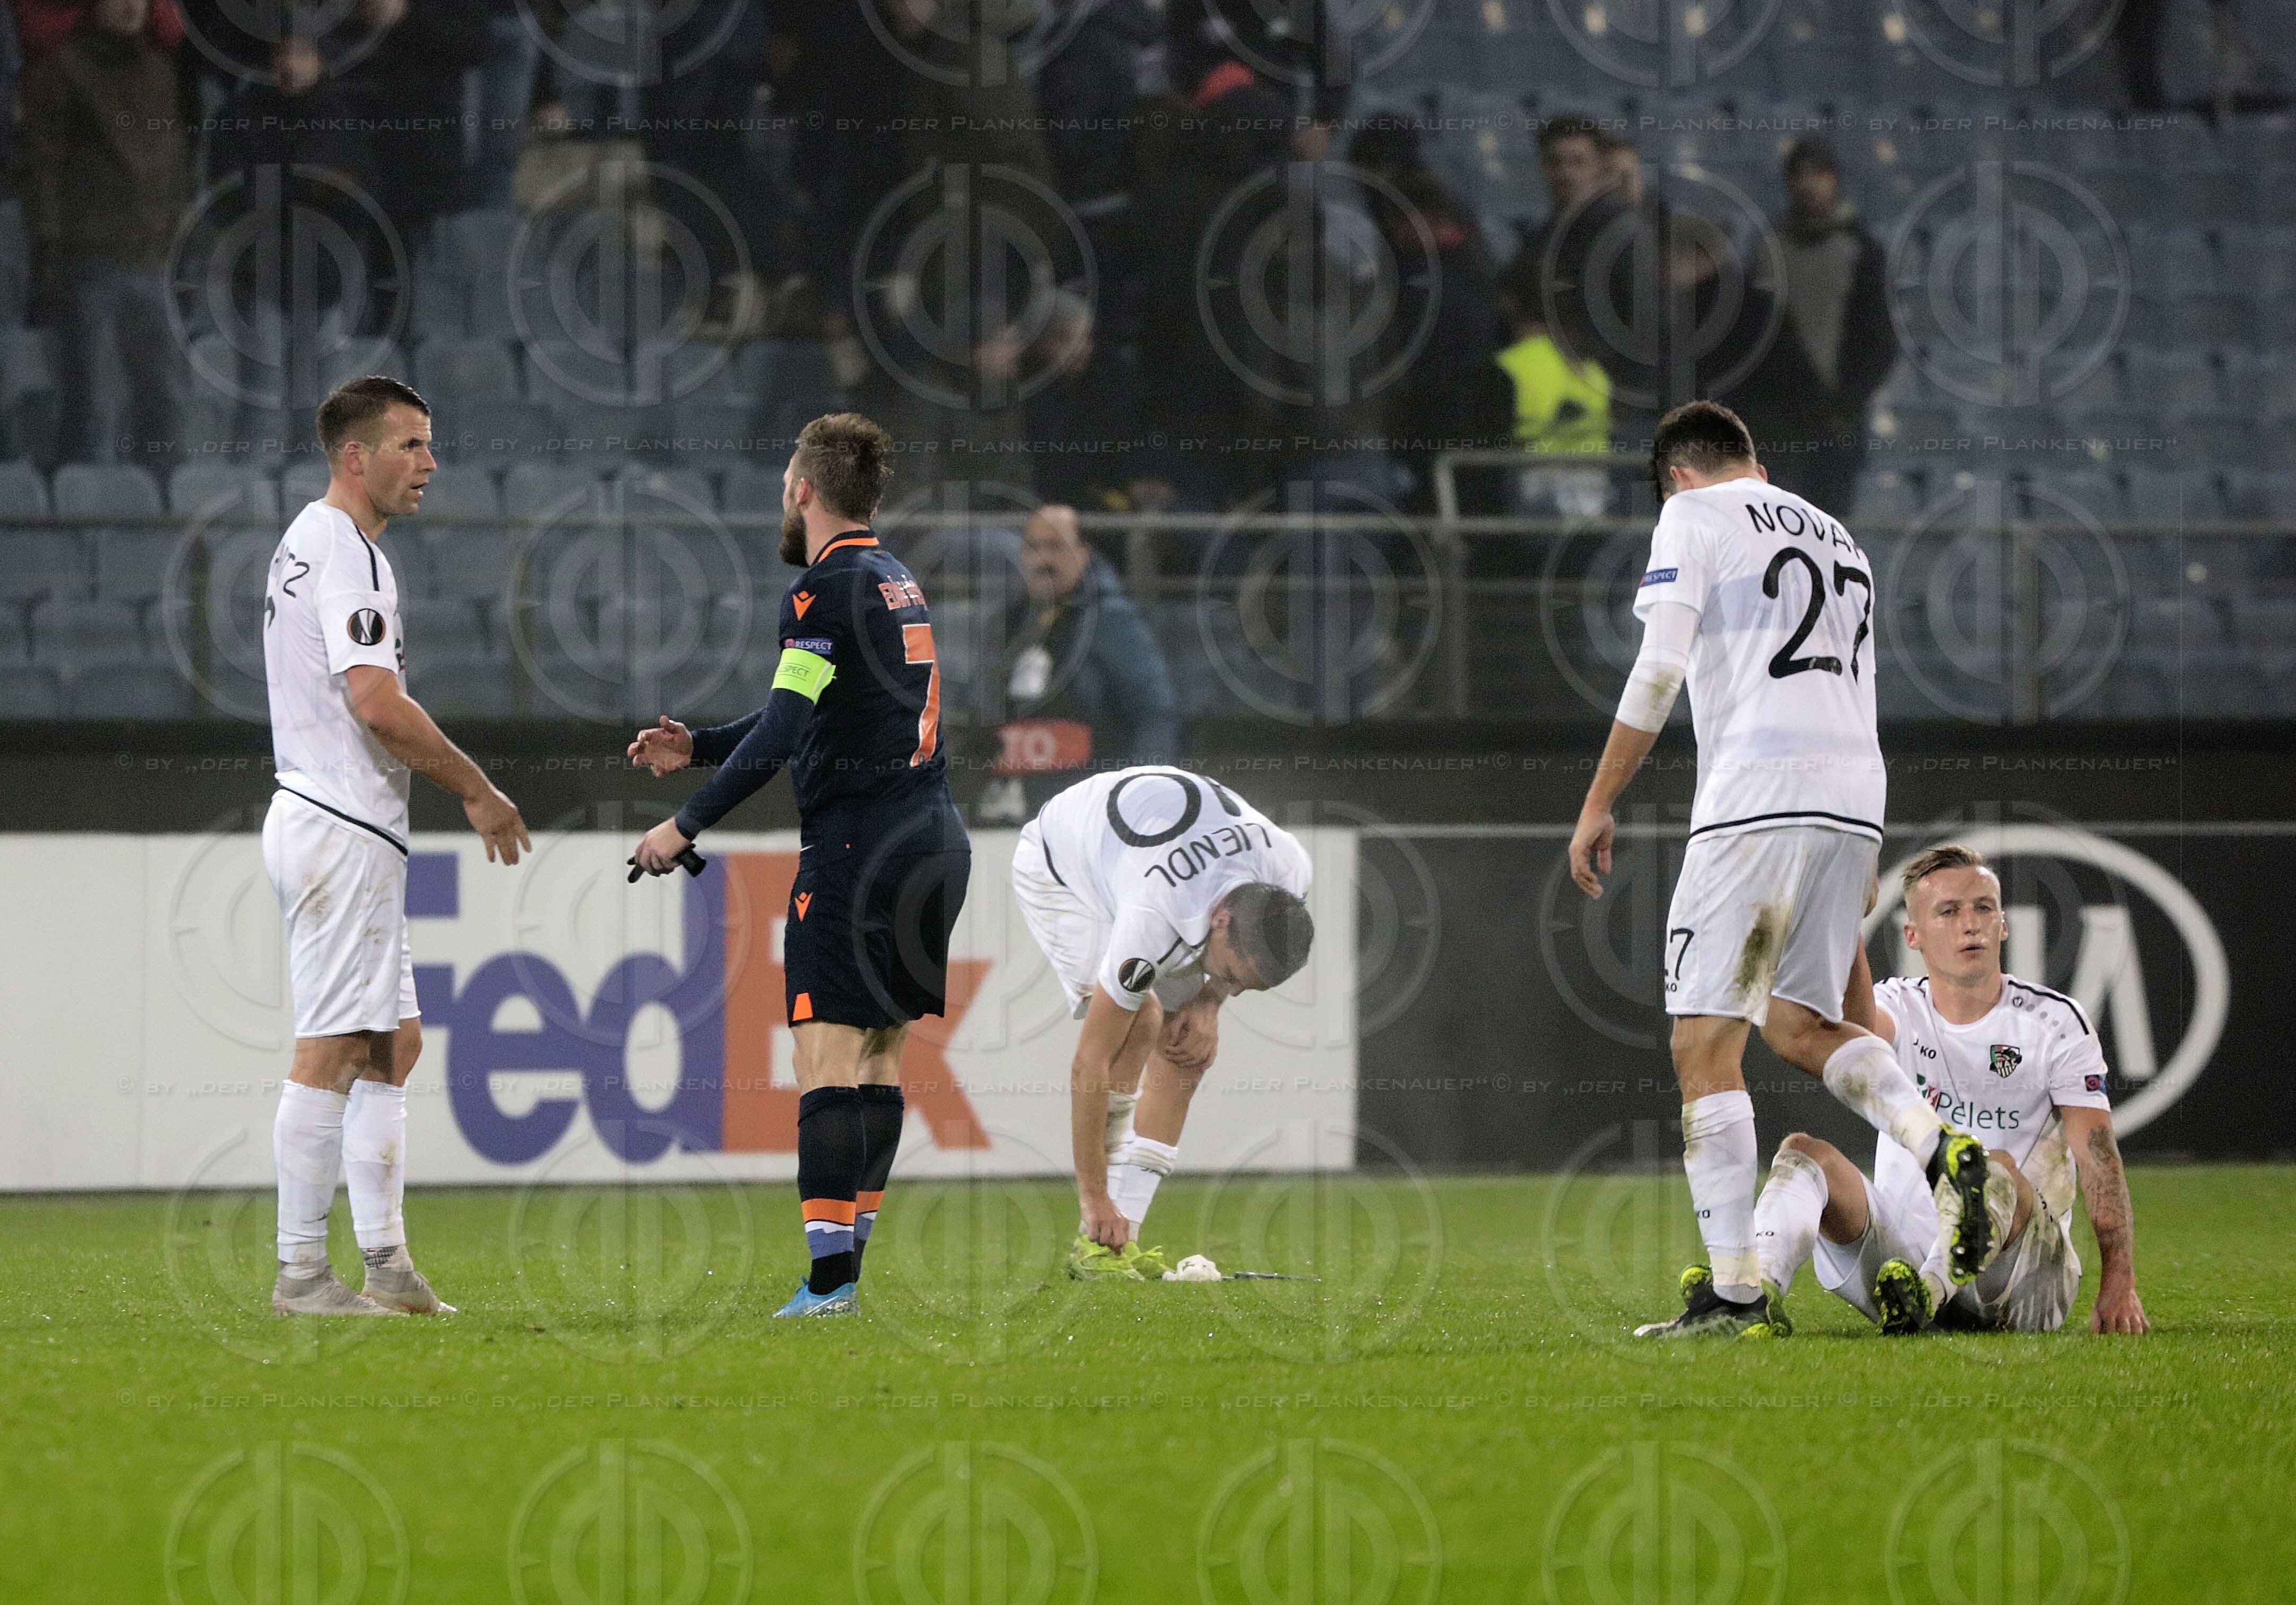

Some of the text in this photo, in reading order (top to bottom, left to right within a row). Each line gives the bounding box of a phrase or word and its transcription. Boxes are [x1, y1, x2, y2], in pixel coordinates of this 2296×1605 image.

[1762, 546, 1871, 685] 27
[795, 641, 832, 650] RESPECT
[903, 623, 940, 767] 7
[1144, 822, 1273, 888] LIENDL
[1665, 928, 1694, 981] 7
[1913, 1039, 1937, 1059] JKO
